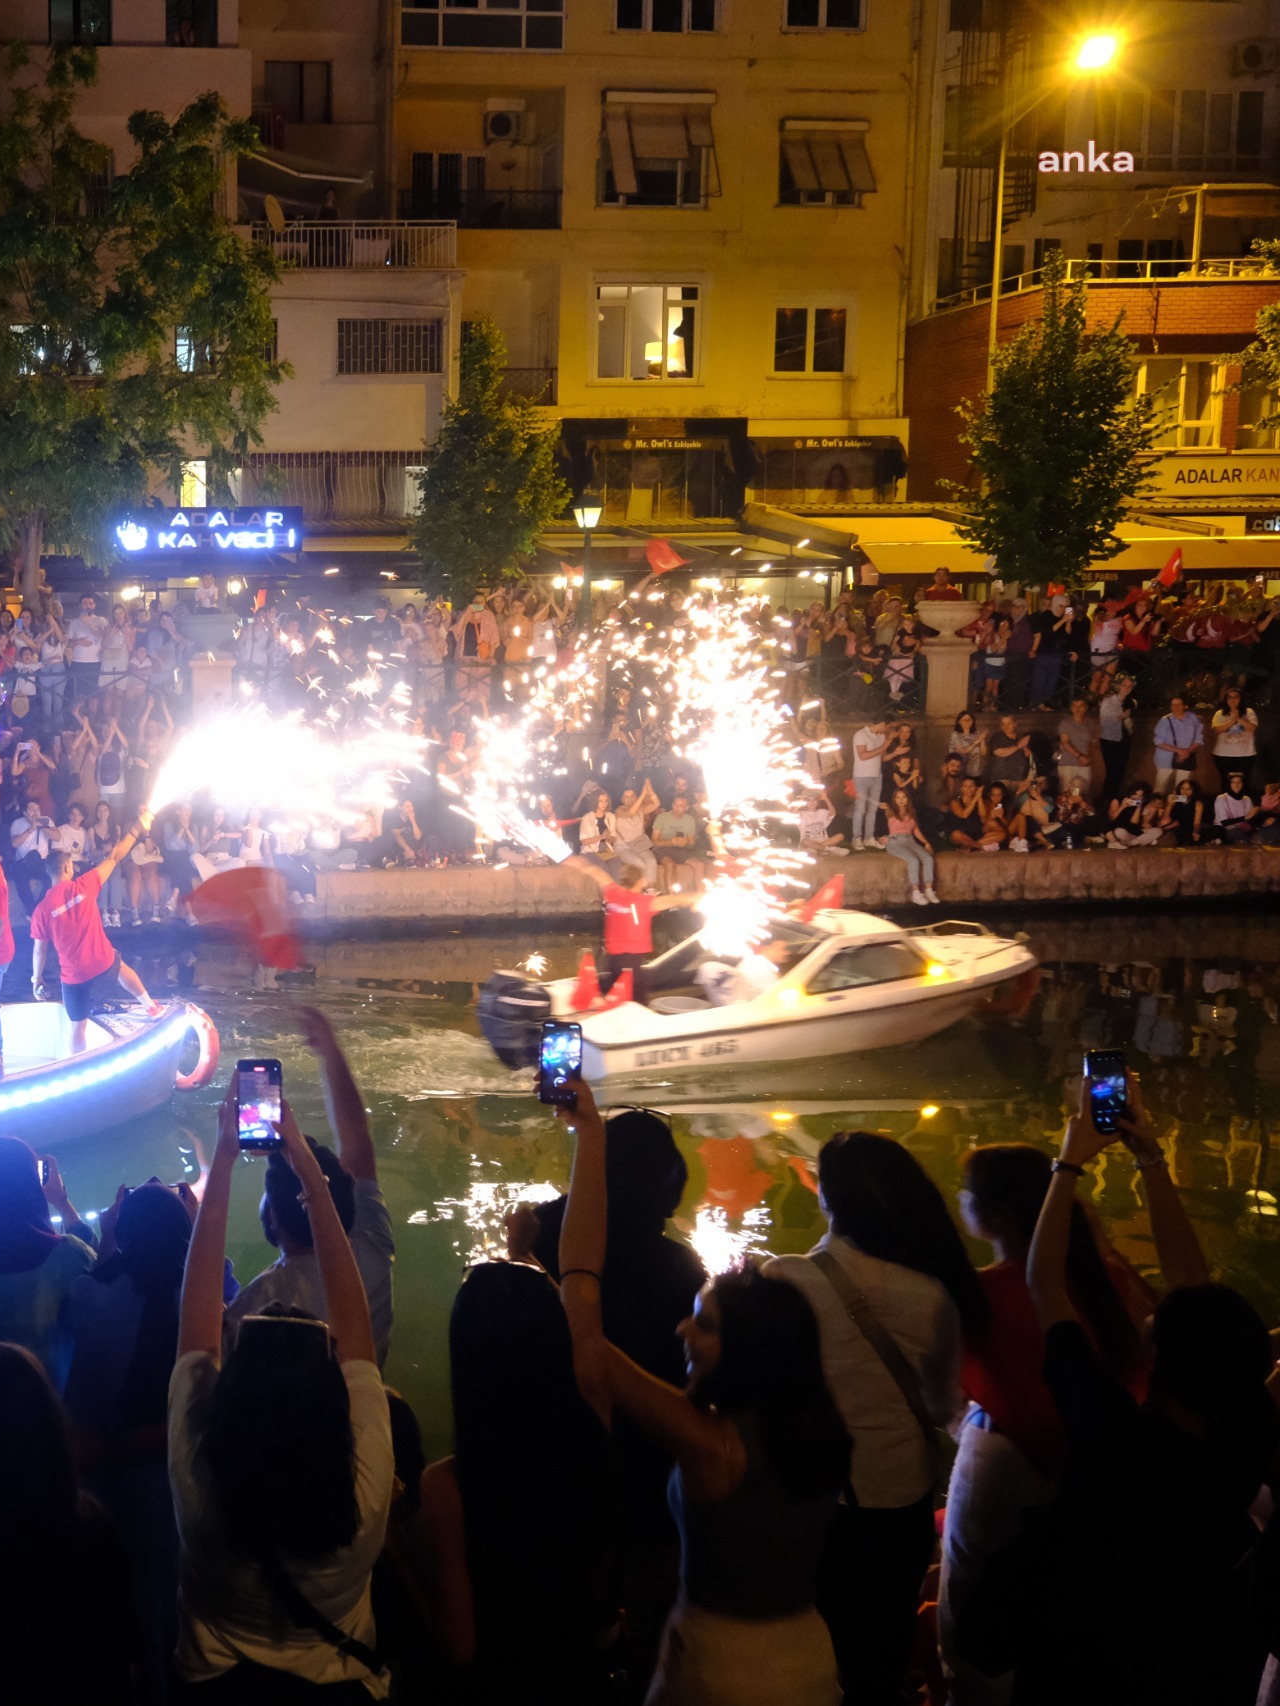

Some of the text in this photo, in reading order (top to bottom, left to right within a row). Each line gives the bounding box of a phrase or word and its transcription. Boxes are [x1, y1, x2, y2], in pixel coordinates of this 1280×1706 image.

[635, 439, 649, 449] Mr.
[650, 439, 673, 449] Owl's
[806, 439, 820, 448] Mr.
[821, 438, 843, 448] Owl's
[1175, 467, 1243, 485] ADALAR
[170, 512, 285, 528] ADALAR
[1081, 572, 1119, 581] DE PARIS
